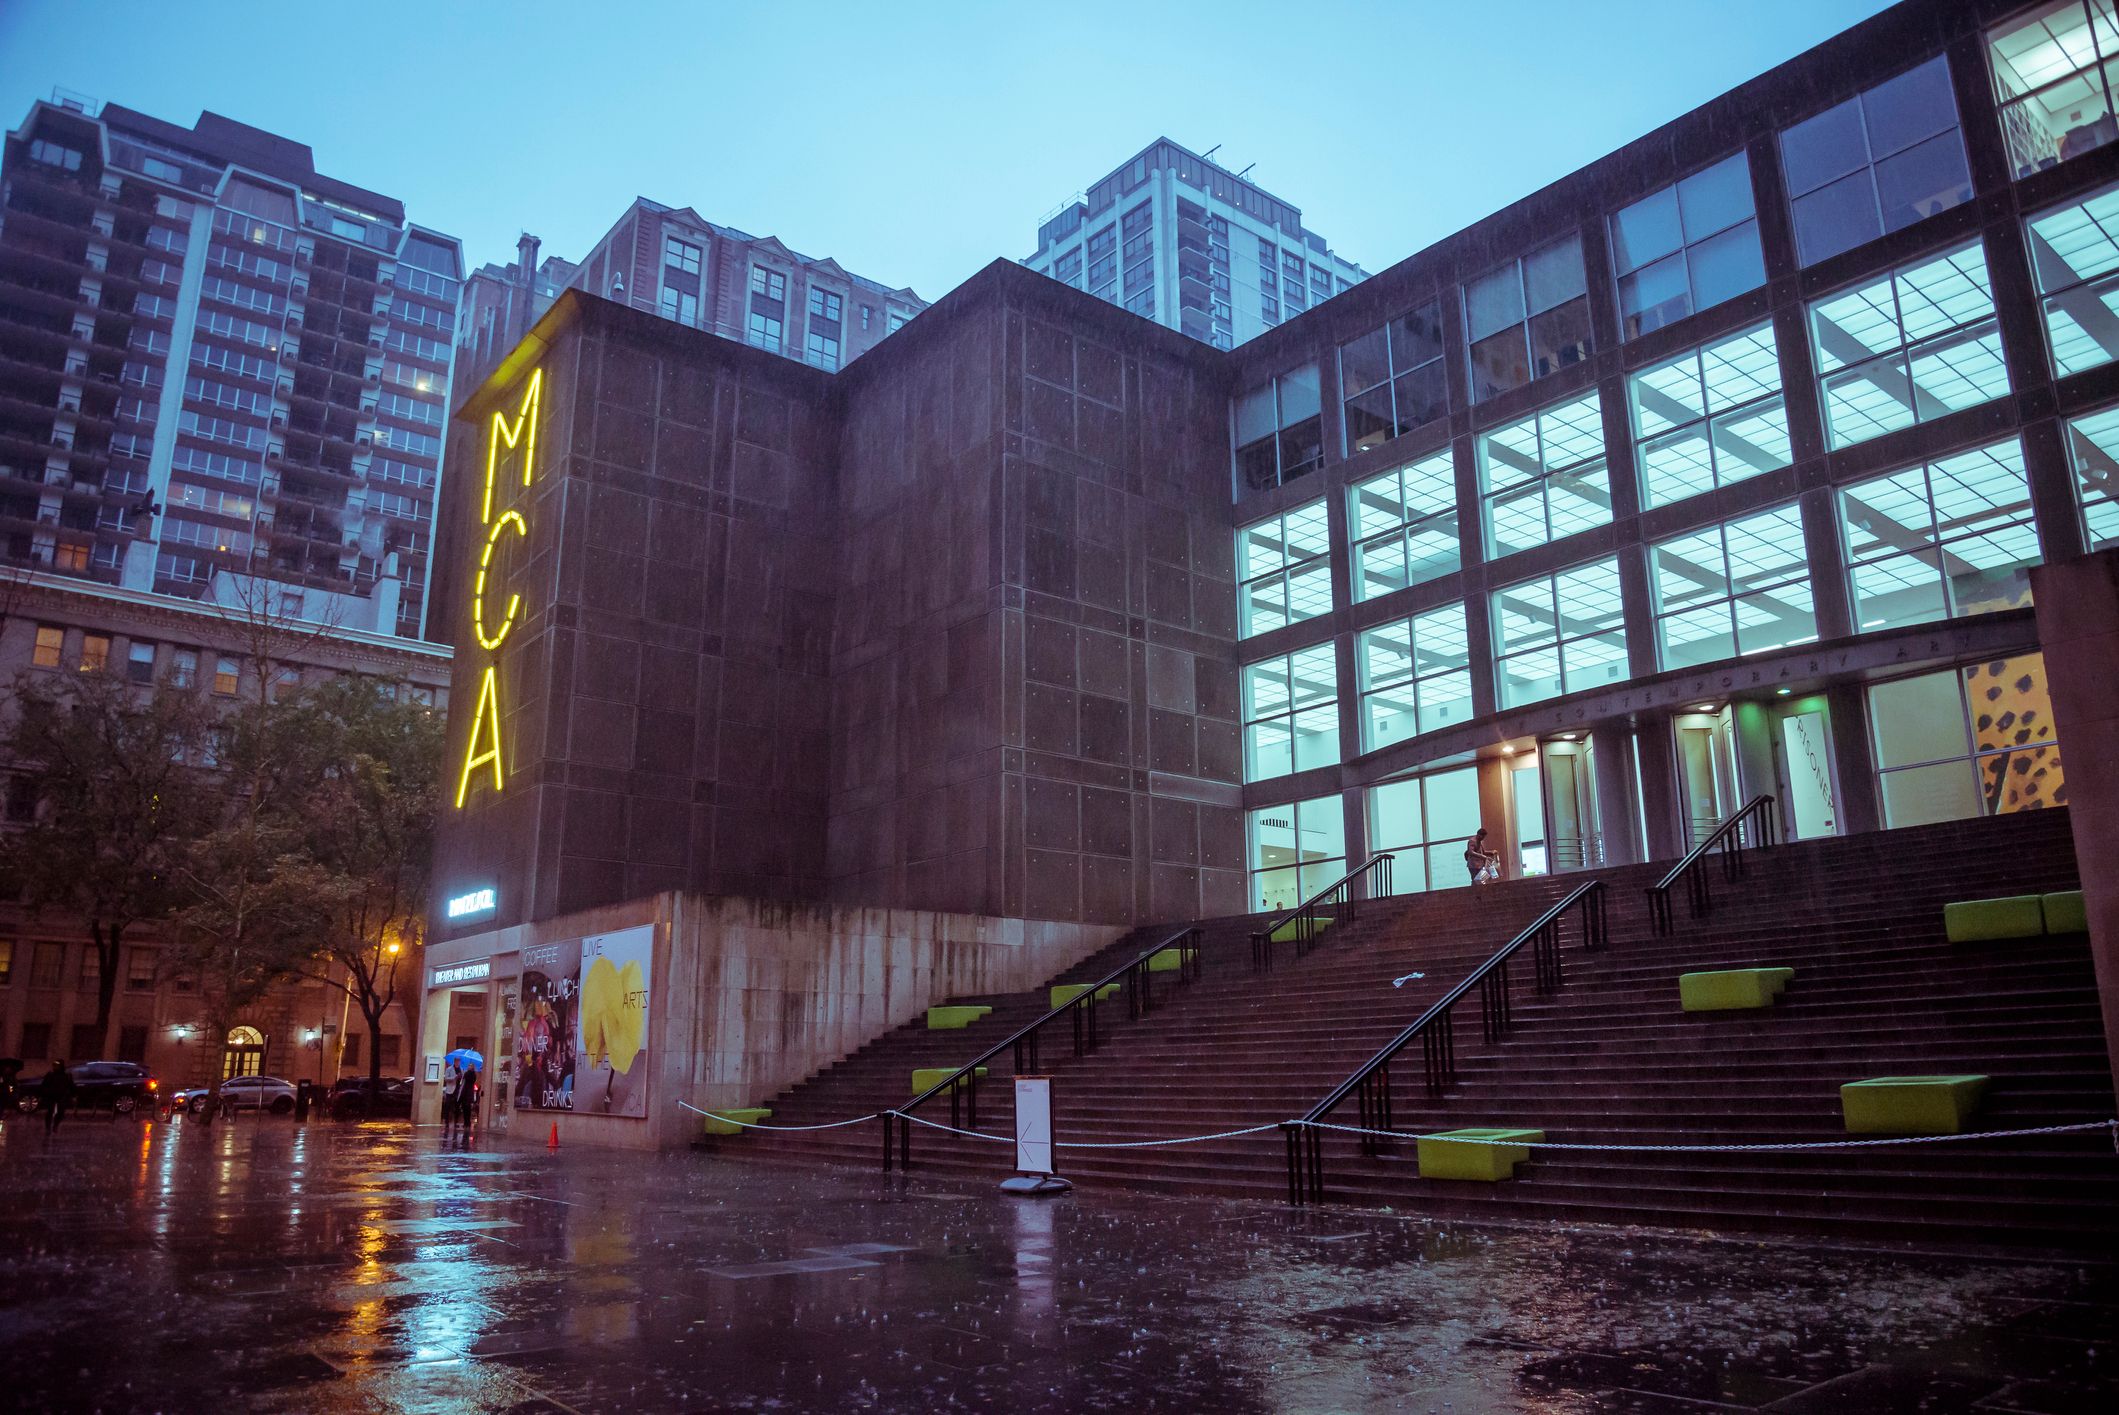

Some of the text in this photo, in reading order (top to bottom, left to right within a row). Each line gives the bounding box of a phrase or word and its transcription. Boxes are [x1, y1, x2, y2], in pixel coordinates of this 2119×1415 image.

[456, 367, 542, 808] MCA
[524, 946, 558, 967] COFFEE
[582, 938, 604, 958] LIVE
[547, 977, 579, 999] LUNCH
[622, 989, 649, 1010] ARTS
[518, 1035, 549, 1054] DINNER
[542, 1090, 574, 1108] DRINKS
